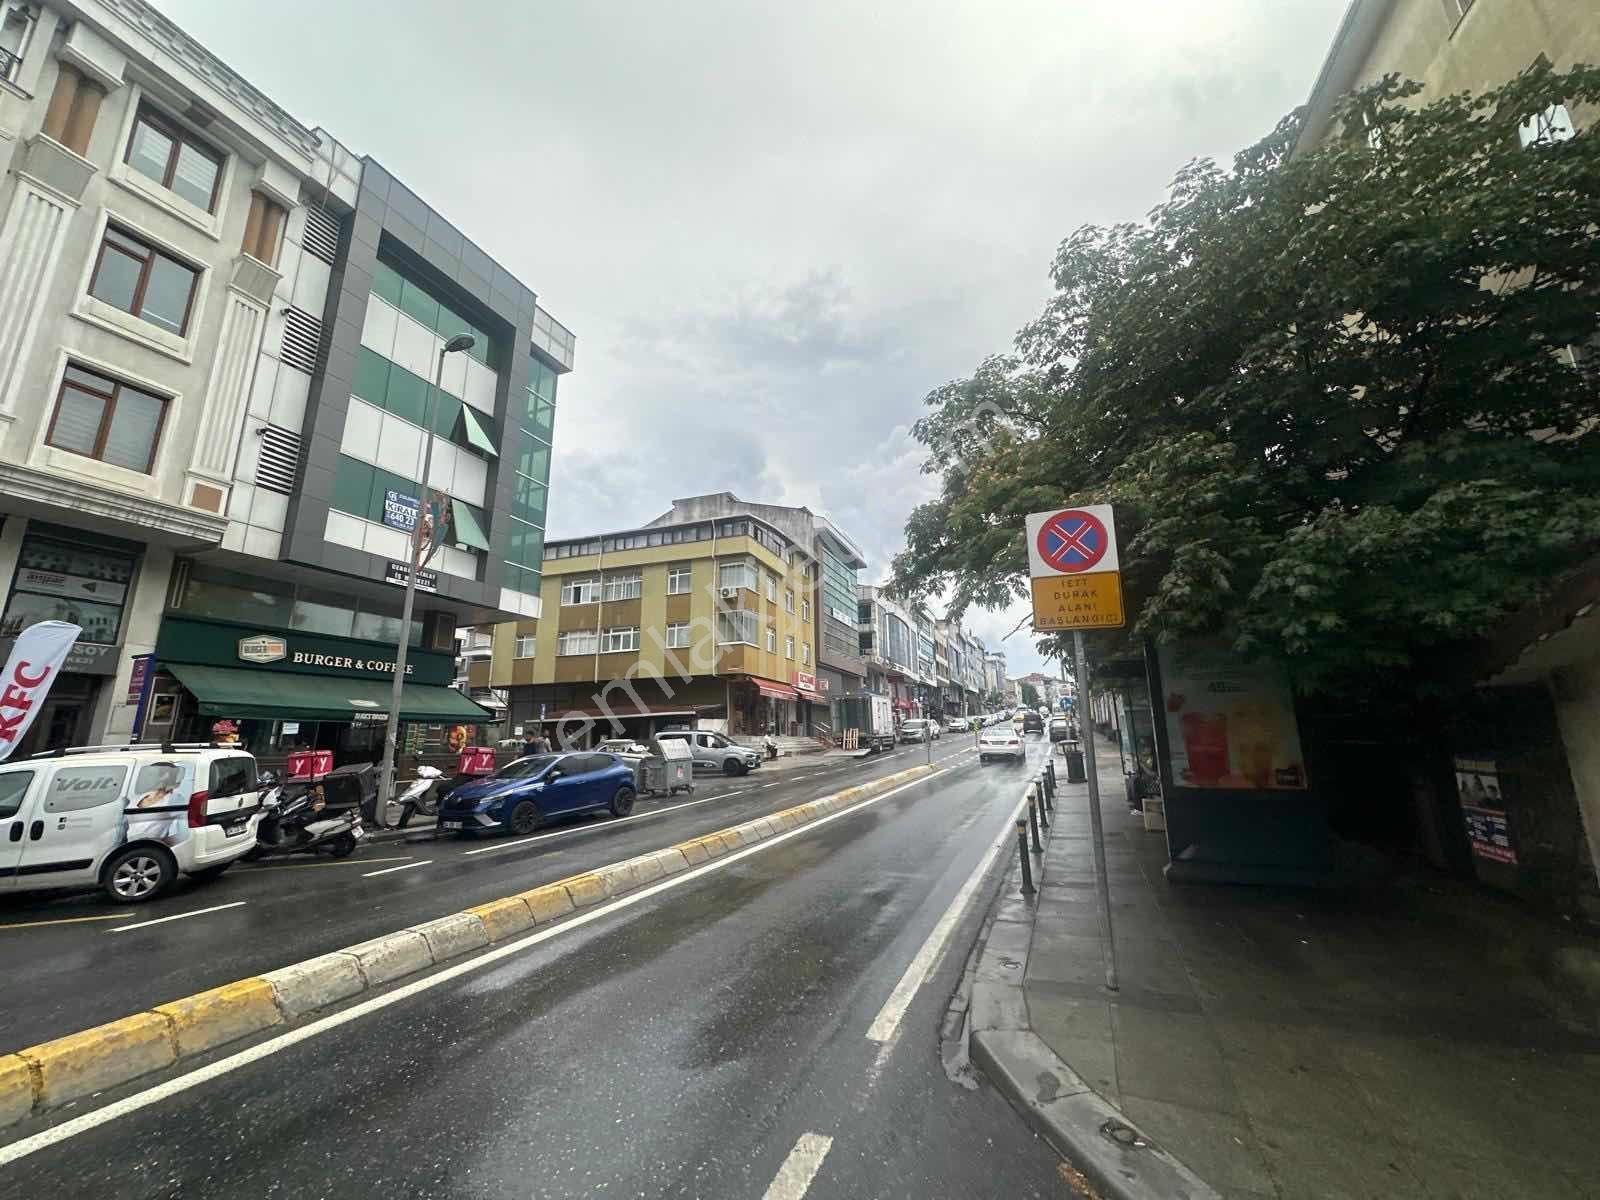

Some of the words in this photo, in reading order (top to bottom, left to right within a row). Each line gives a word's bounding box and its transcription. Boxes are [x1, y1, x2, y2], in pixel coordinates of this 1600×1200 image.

[1054, 590, 1097, 600] DURAK
[293, 652, 353, 669] BURGER
[355, 659, 364, 670] &
[366, 660, 414, 674] COFFE
[0, 660, 51, 743] KFC
